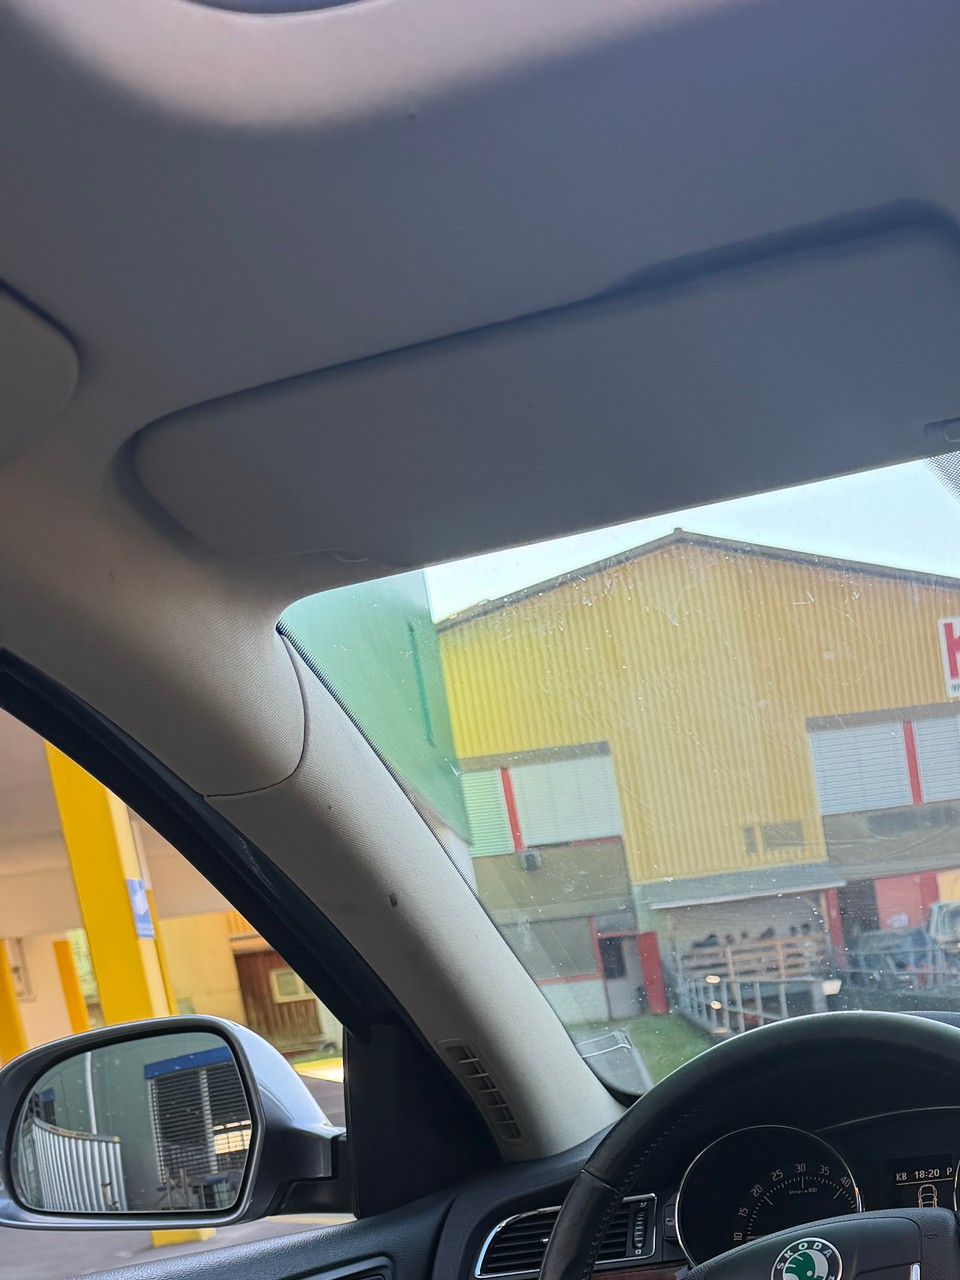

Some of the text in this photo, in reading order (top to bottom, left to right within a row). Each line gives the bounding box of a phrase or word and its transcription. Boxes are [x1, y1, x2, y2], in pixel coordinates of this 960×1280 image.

[795, 1163, 806, 1173] 30
[819, 1165, 830, 1176] 35
[914, 1168, 940, 1179] 18:20
[946, 1167, 953, 1176] P
[770, 1169, 783, 1181] 25
[840, 1176, 851, 1188] 40
[750, 1184, 763, 1197] 20
[738, 1207, 748, 1217] 15
